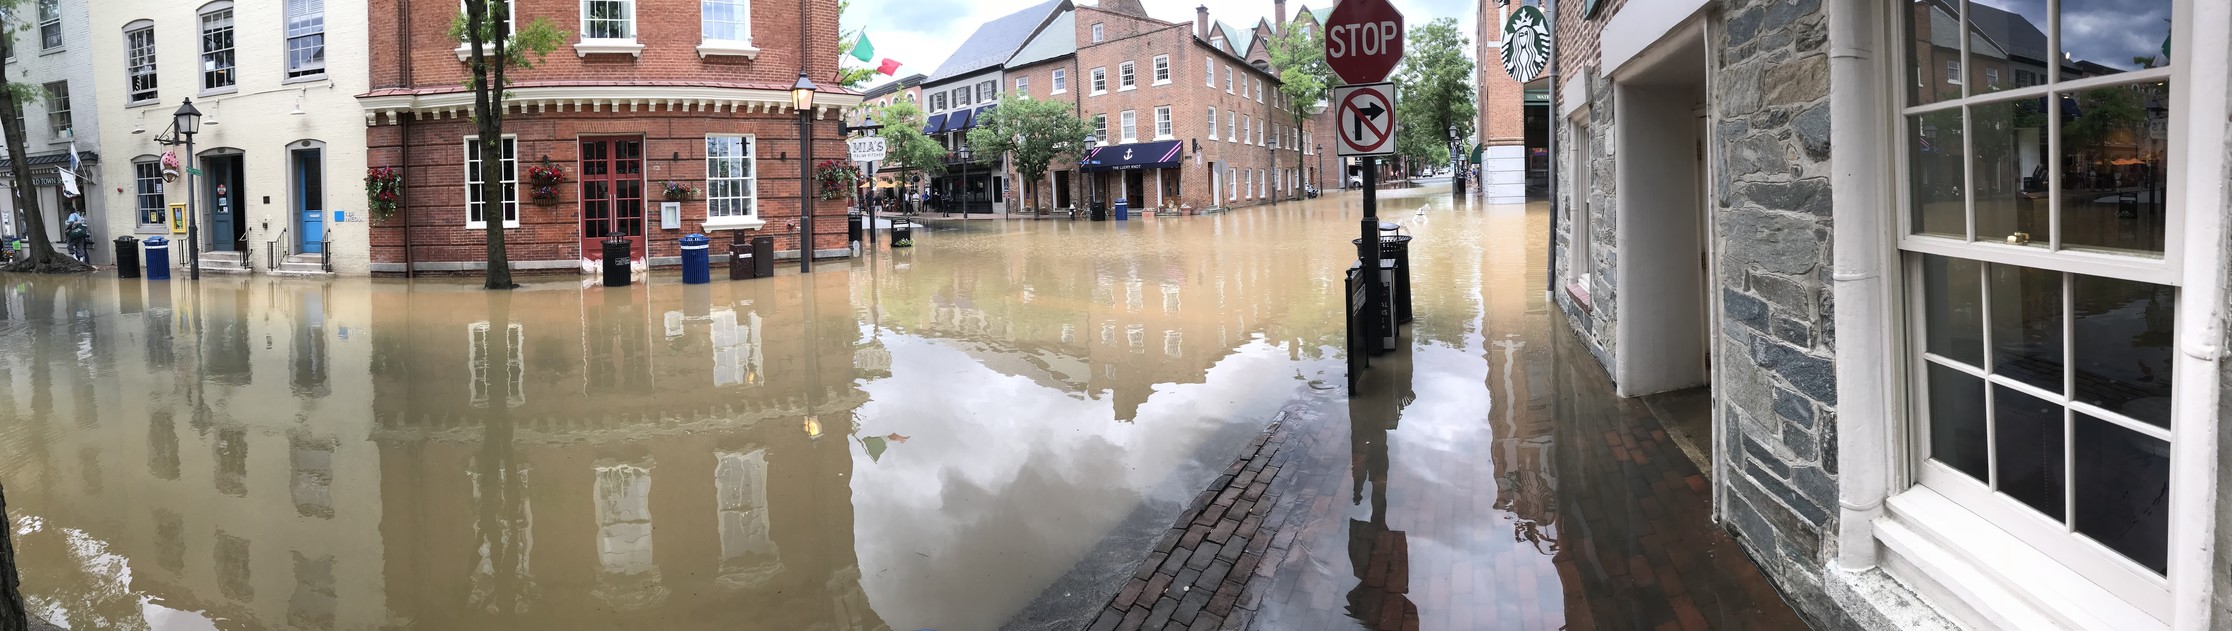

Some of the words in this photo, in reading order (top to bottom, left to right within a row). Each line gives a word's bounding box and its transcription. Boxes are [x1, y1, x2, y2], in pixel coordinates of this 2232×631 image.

[1329, 21, 1397, 58] STOP
[852, 141, 884, 153] MIA'S
[41, 177, 56, 185] TOWN
